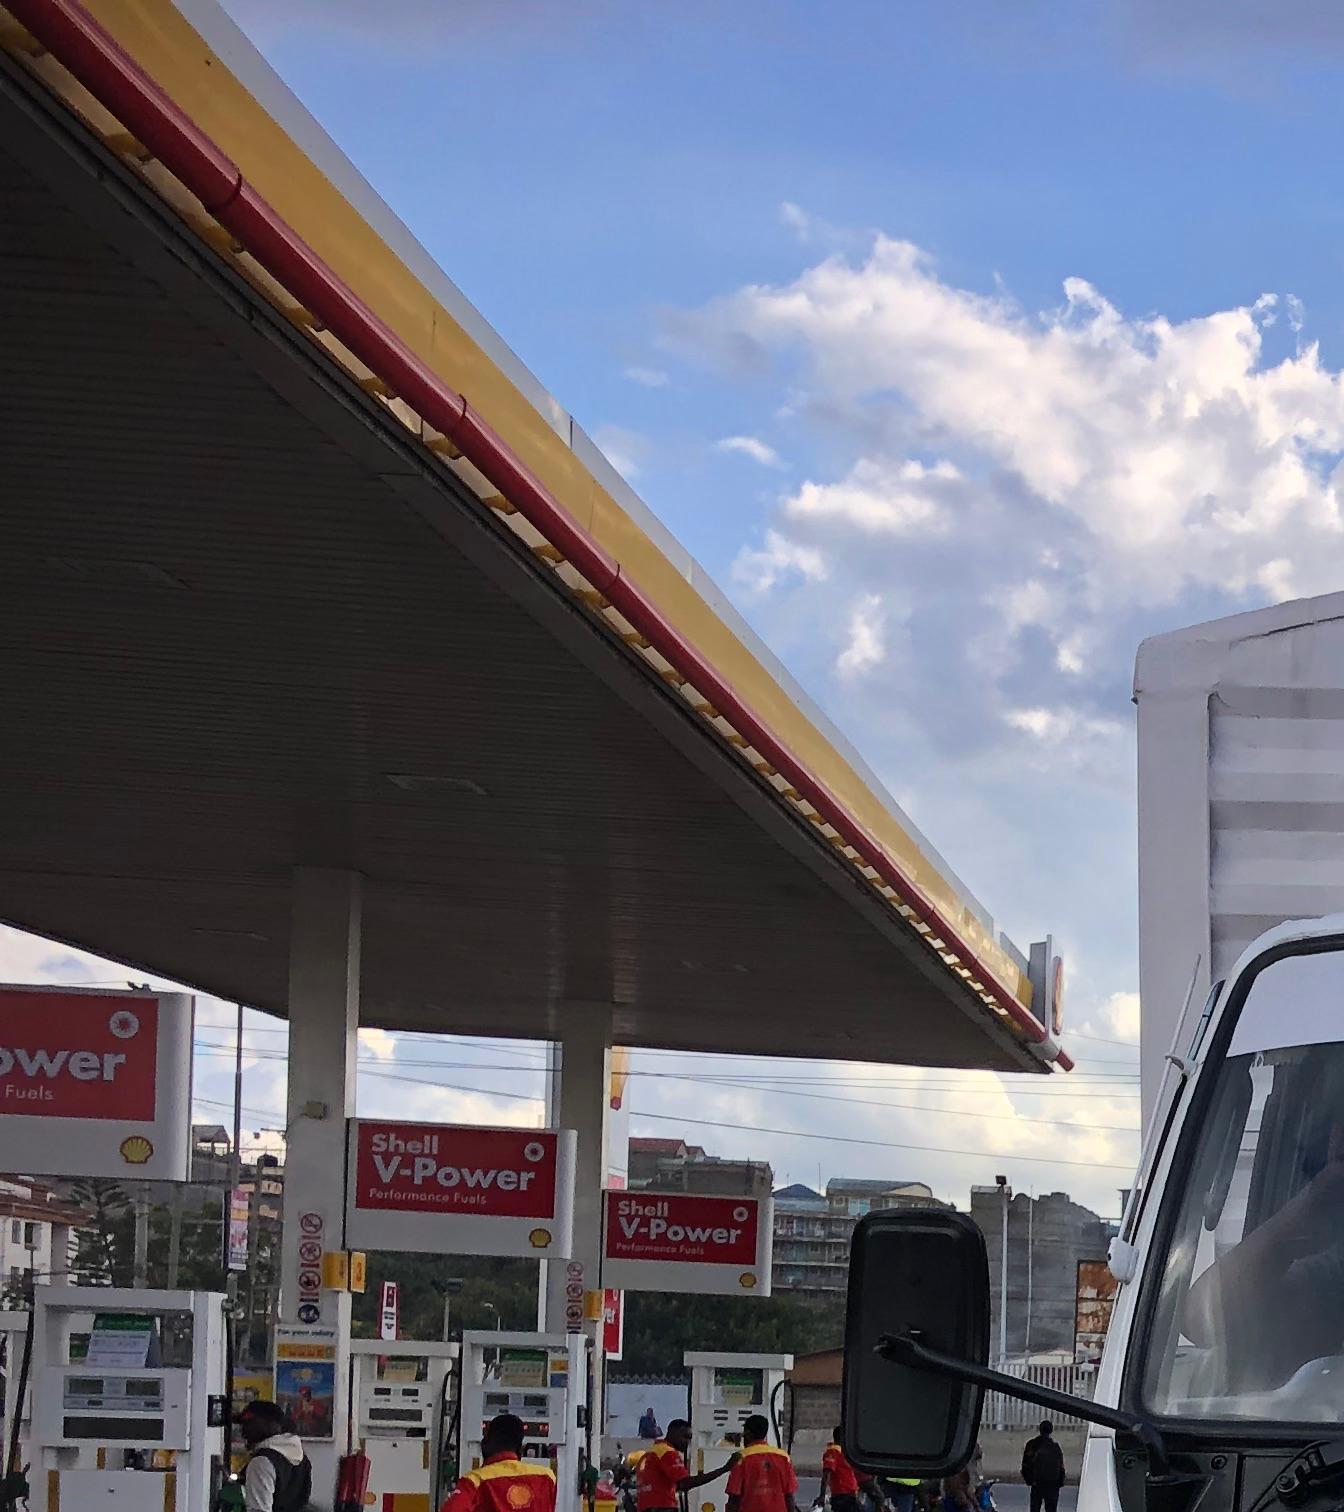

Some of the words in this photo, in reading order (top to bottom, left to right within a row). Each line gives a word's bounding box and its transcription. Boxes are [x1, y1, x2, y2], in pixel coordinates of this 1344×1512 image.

[4, 1083, 55, 1101] Fuels
[371, 1132, 440, 1155] Shell
[372, 1154, 536, 1192] V-Power
[368, 1187, 450, 1203] Performance
[453, 1191, 488, 1206] Fuels
[617, 1200, 670, 1218] Shell
[618, 1216, 742, 1245] V-Power
[679, 1244, 705, 1256] Fuels
